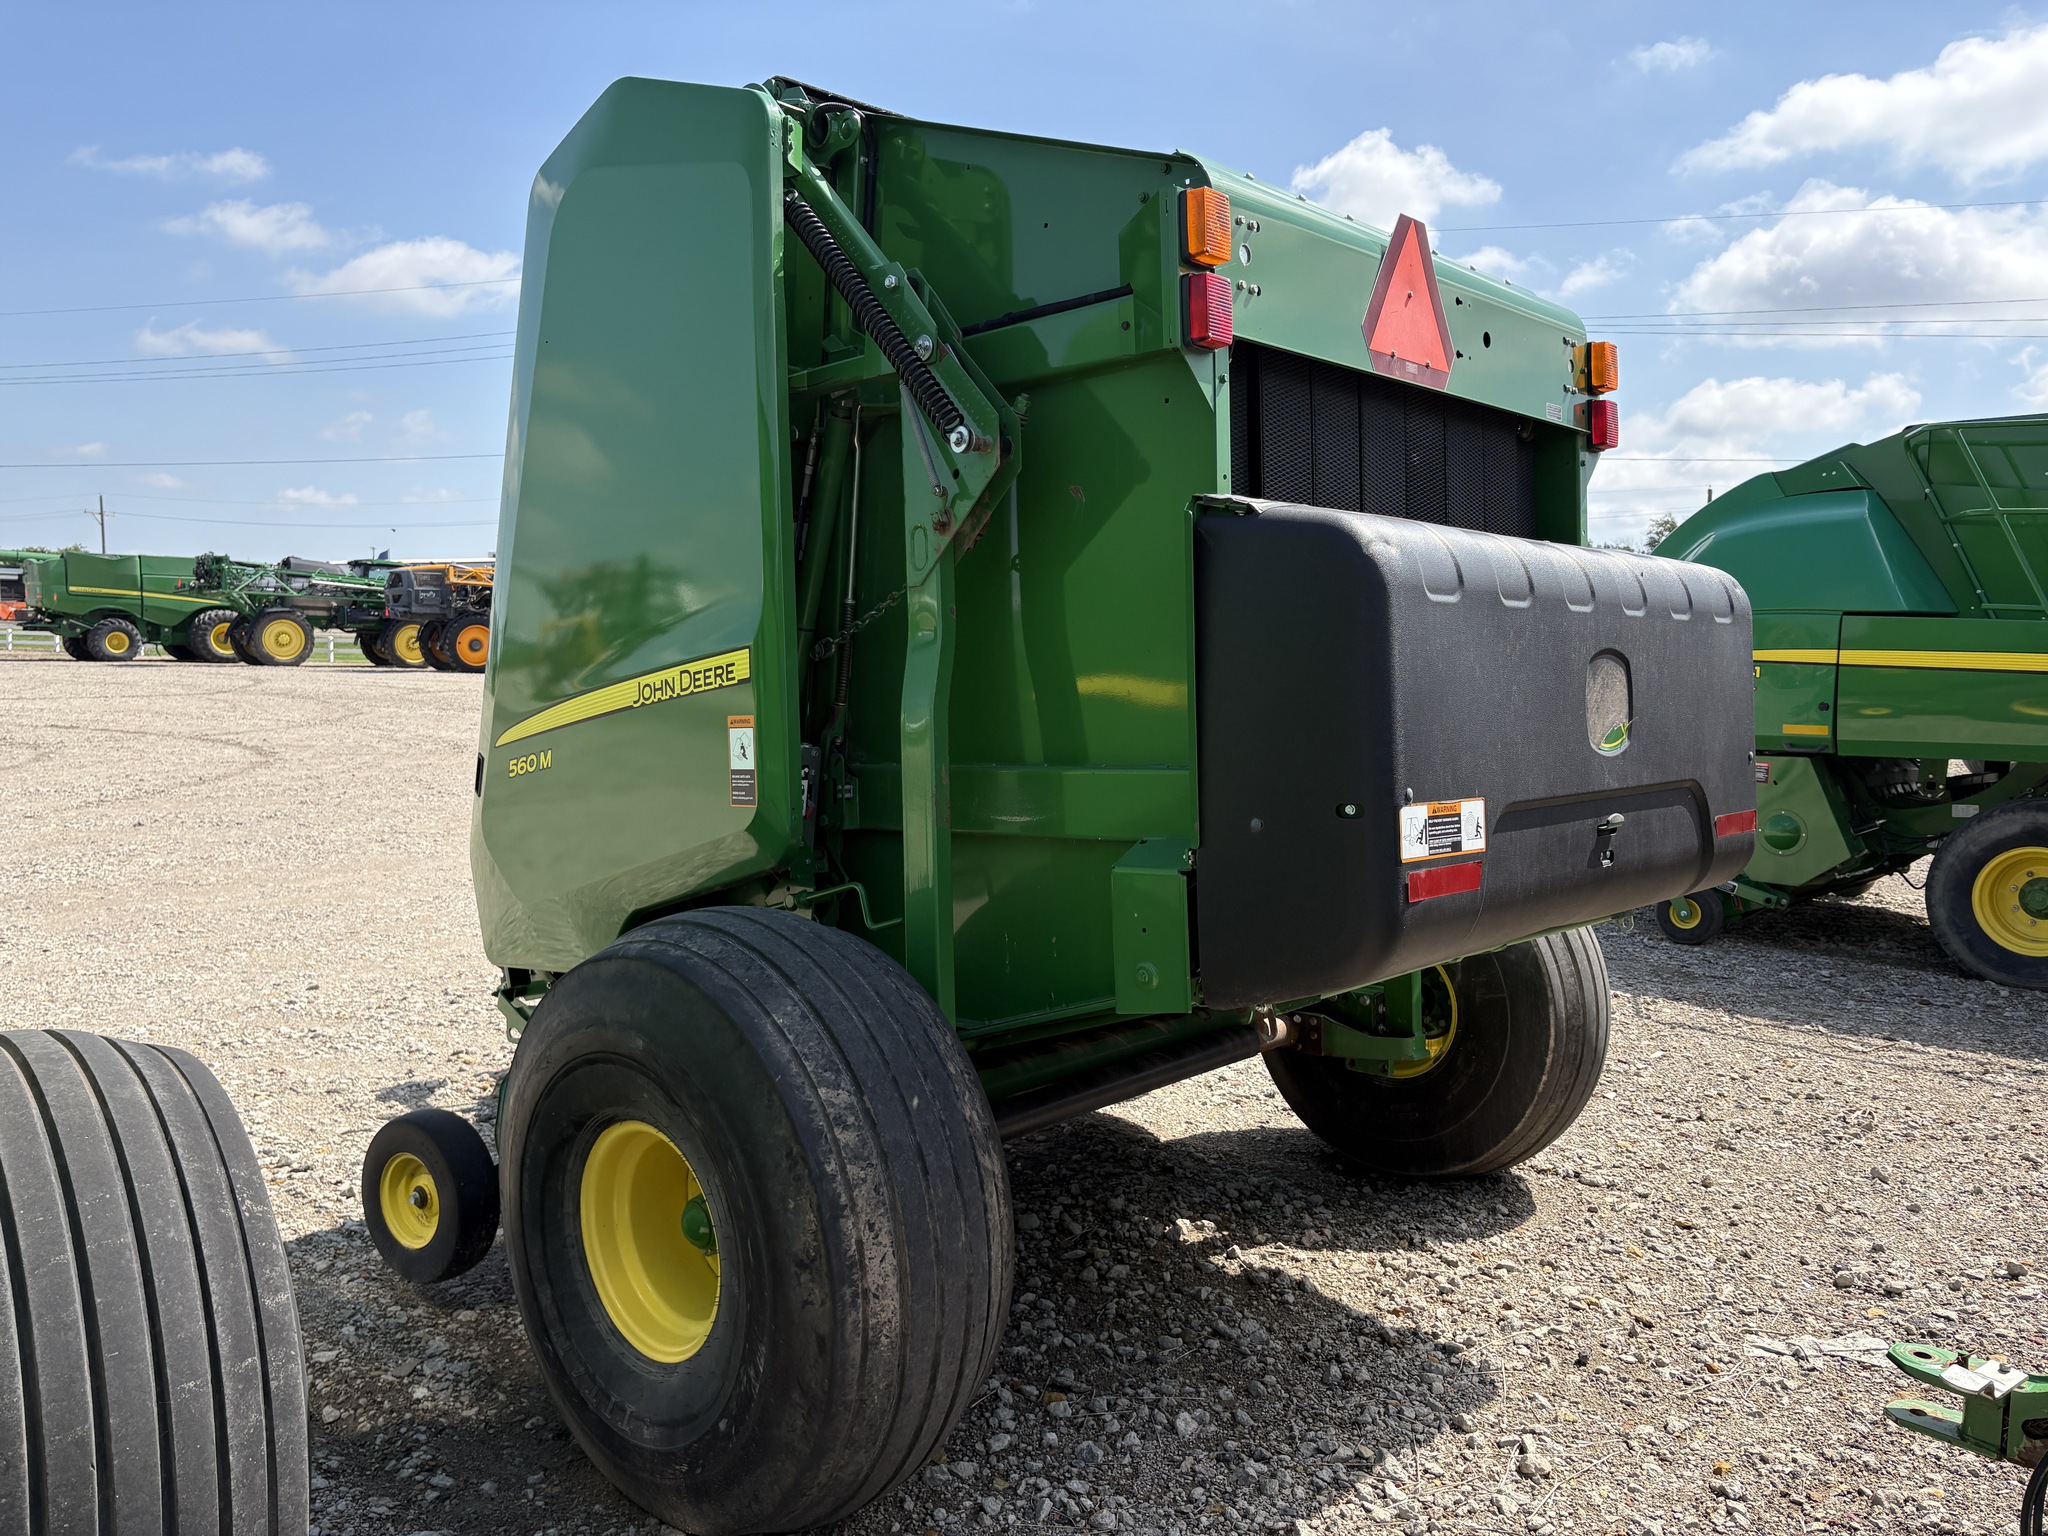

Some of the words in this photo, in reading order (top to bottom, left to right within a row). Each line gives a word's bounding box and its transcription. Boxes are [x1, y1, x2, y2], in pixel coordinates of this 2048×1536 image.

[632, 676, 676, 705] JOHN
[679, 662, 736, 693] DEERE
[508, 753, 538, 778] 560
[539, 748, 553, 771] M
[1436, 804, 1458, 814] WARNING
